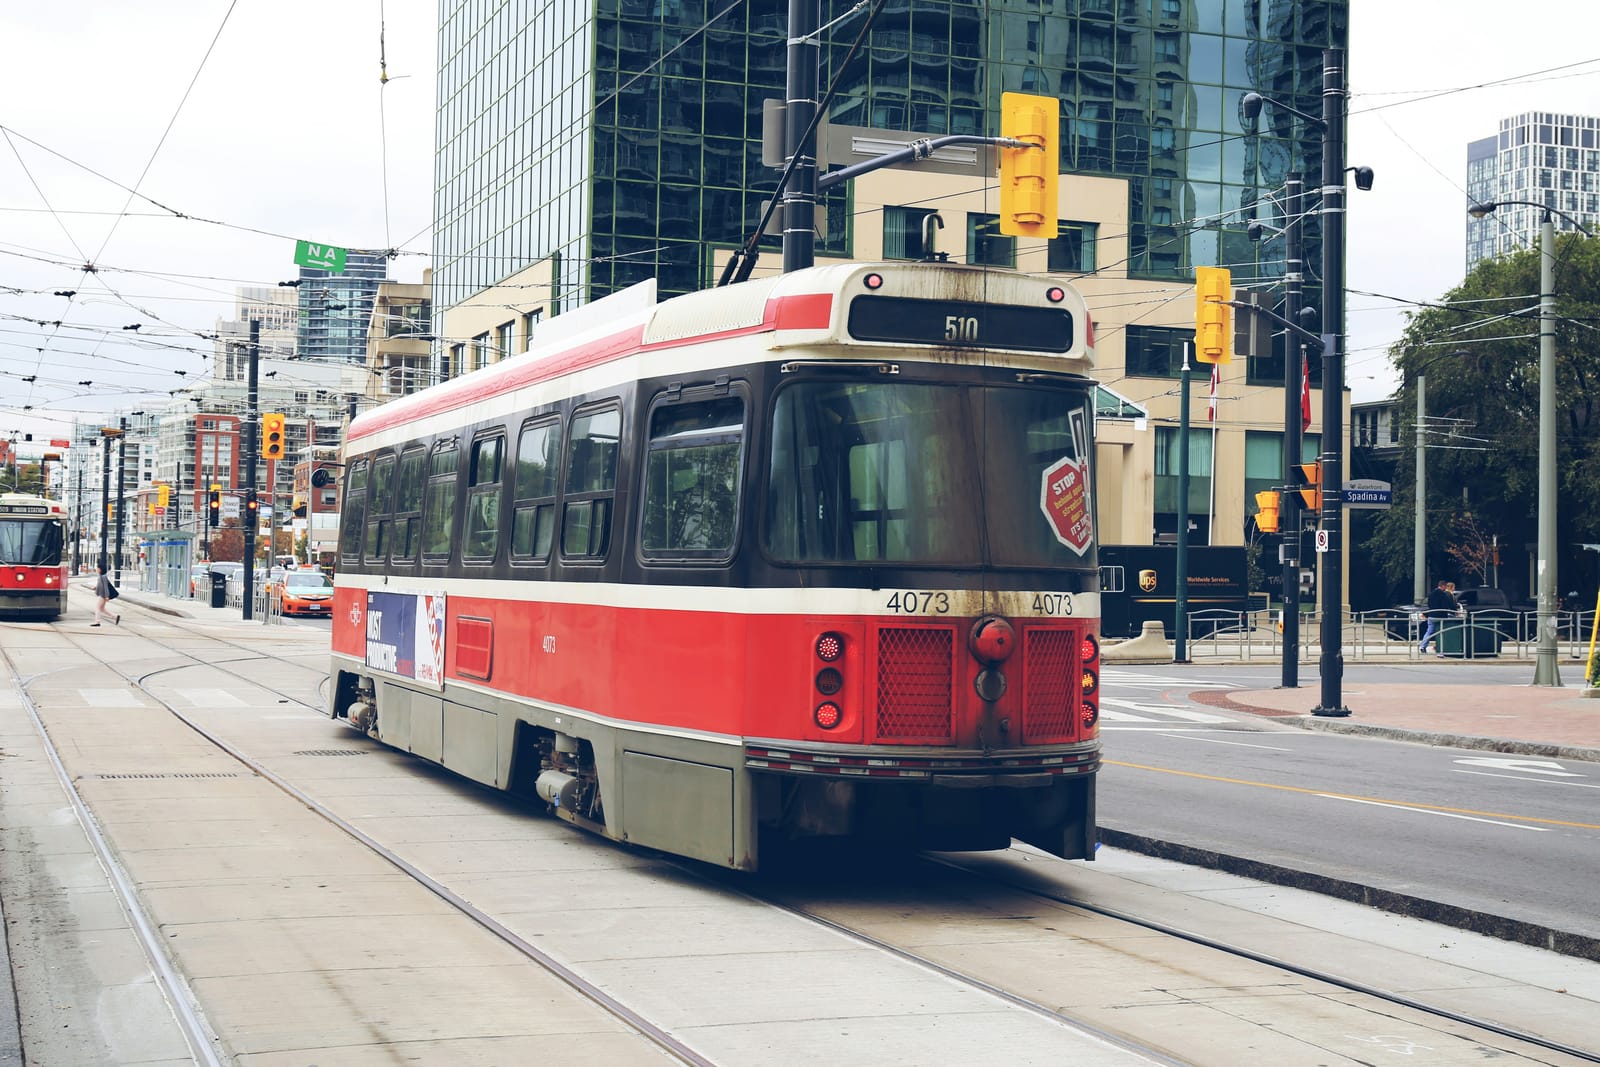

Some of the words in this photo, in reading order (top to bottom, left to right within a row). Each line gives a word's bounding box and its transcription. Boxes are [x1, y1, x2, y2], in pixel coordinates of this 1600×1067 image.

[945, 316, 979, 341] 510
[1052, 471, 1076, 495] STOP
[1347, 491, 1378, 502] Spadina
[1378, 493, 1387, 501] Av
[1141, 576, 1156, 588] ups
[886, 591, 950, 613] 4073
[1032, 593, 1073, 616] 4073
[367, 609, 382, 641] MOST
[543, 635, 556, 654] 4073
